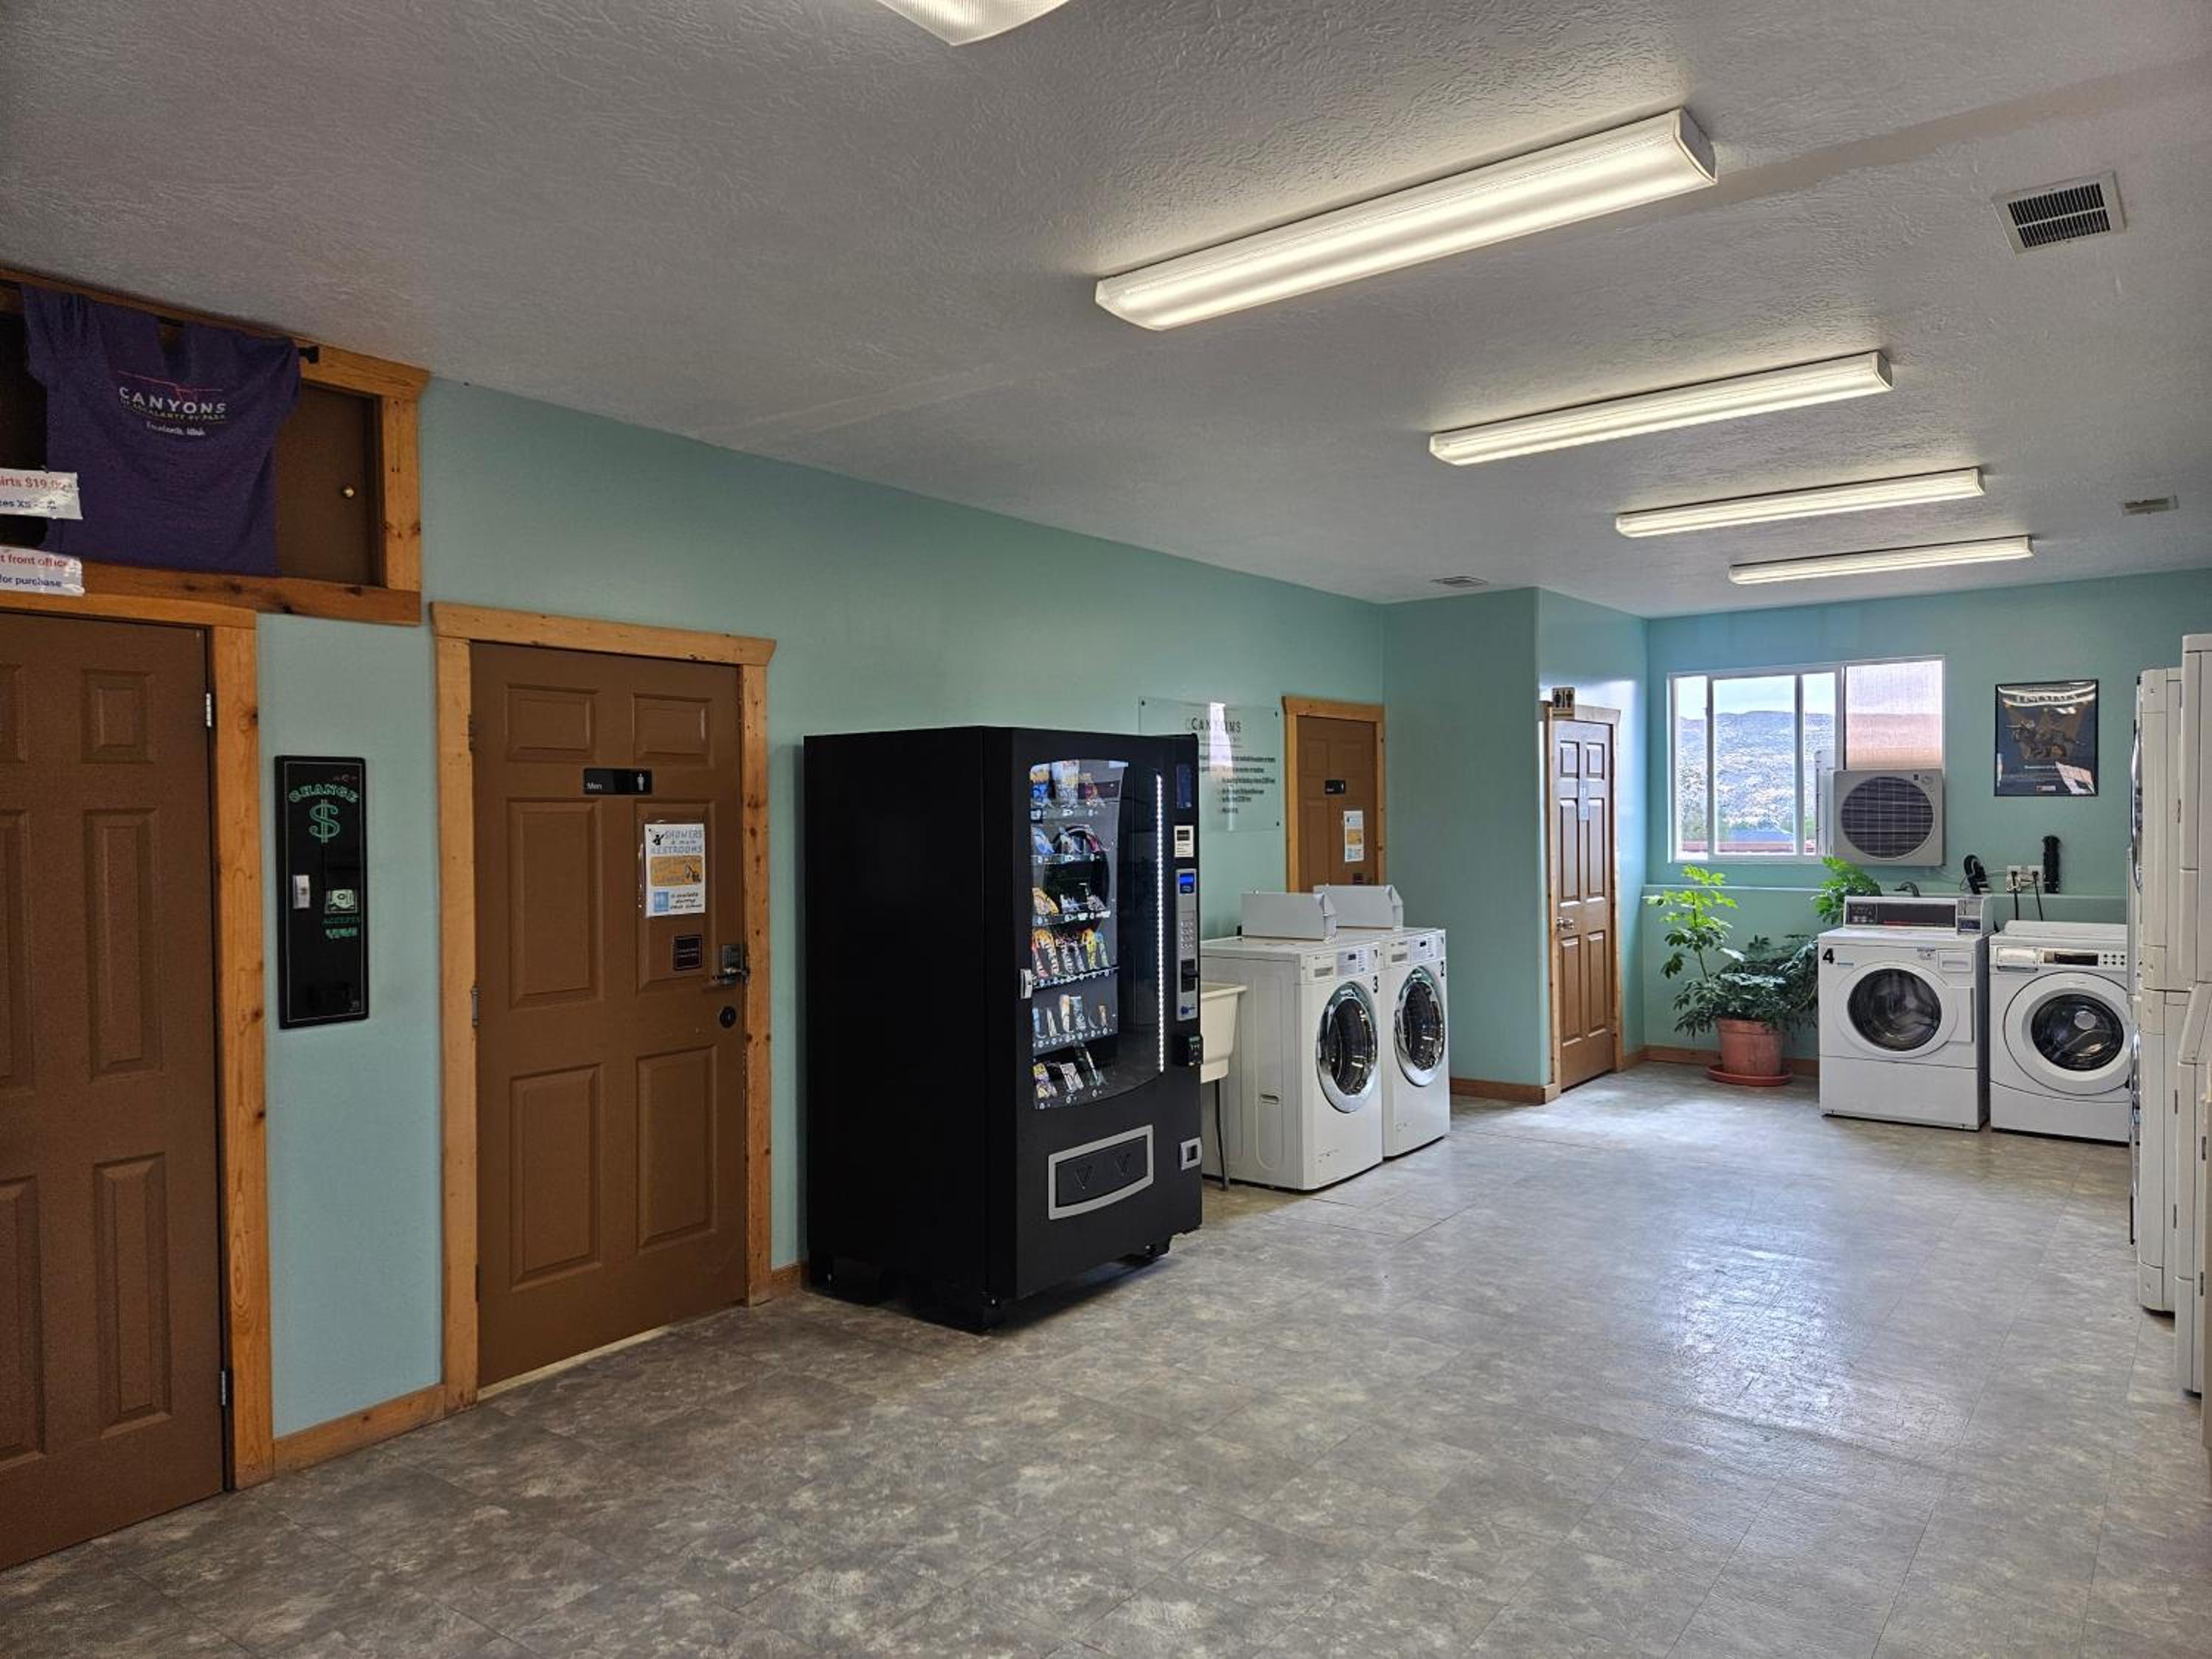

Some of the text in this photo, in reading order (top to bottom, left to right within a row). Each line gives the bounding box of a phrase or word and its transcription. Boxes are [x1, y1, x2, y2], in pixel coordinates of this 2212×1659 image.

[119, 387, 226, 414] CANYONS
[8, 554, 35, 566] front
[15, 577, 62, 588] purchase
[288, 784, 360, 803] CHANGE
[586, 782, 602, 790] Men
[1822, 948, 1835, 964] 4
[1373, 975, 1379, 993] 3
